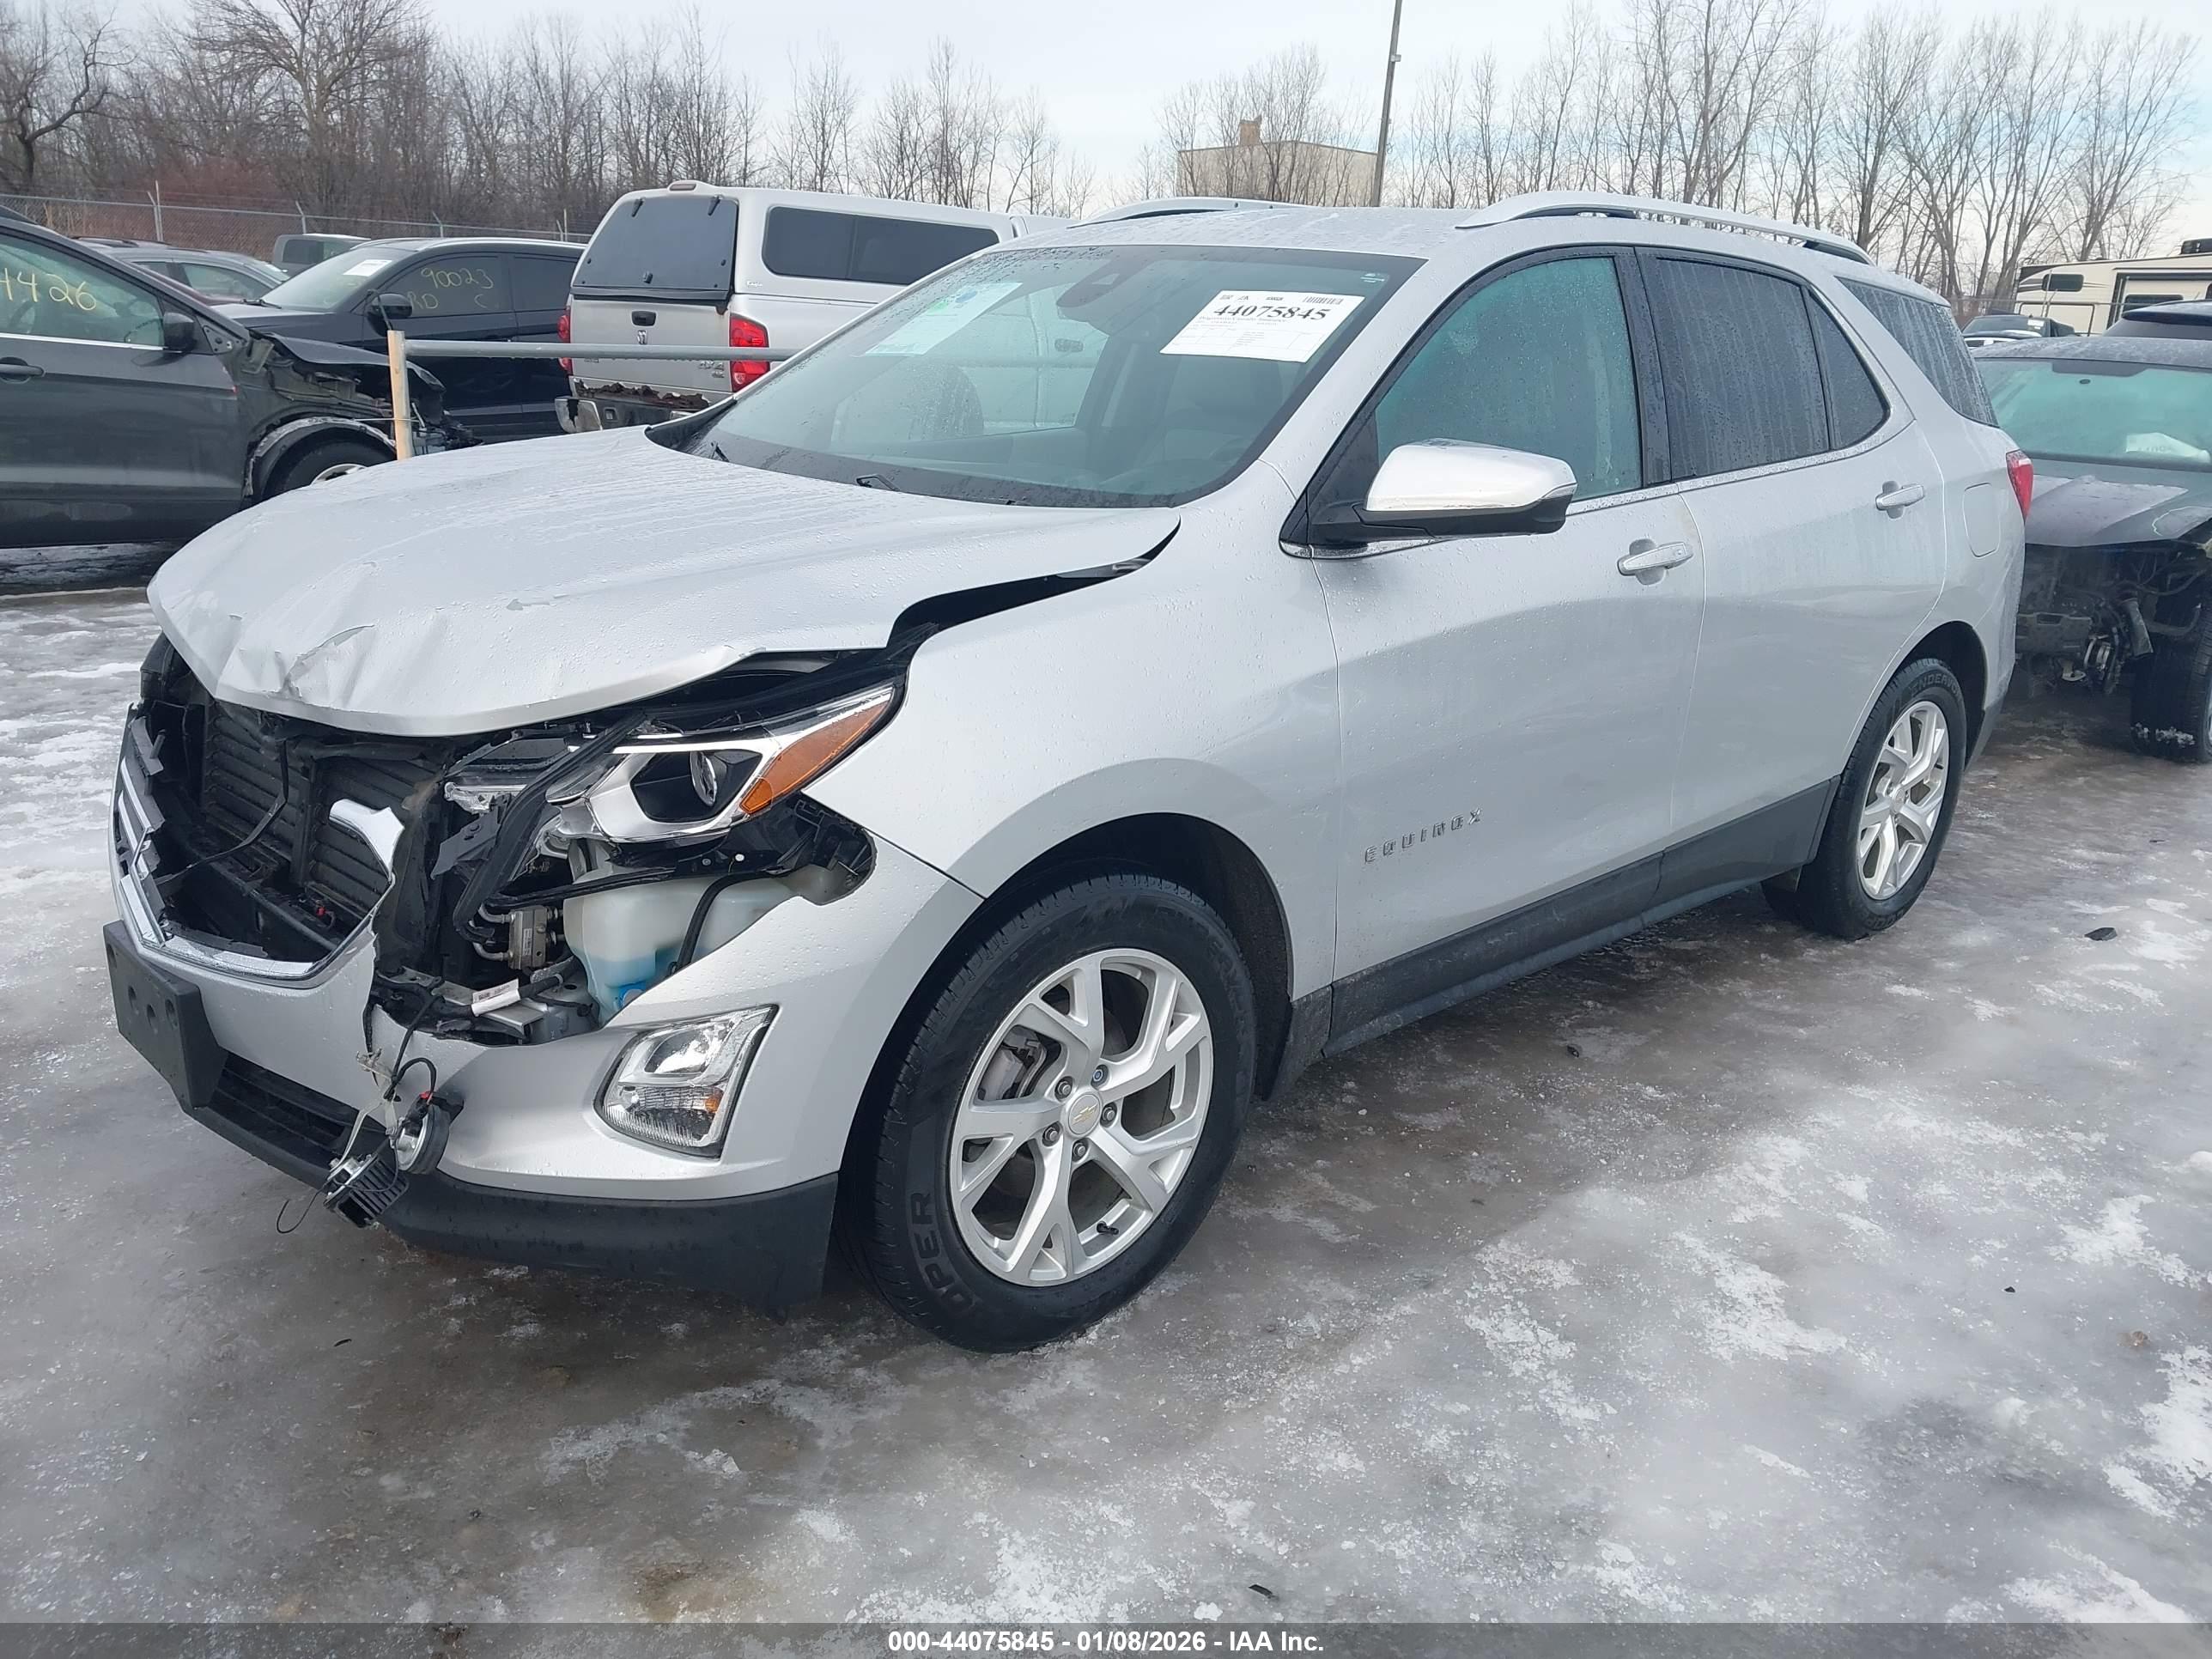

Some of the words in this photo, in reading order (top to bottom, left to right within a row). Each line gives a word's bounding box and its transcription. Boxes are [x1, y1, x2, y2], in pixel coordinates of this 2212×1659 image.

[420, 267, 494, 289] 90023
[1213, 304, 1332, 320] 44075845
[1364, 807, 1483, 864] EQUINOX
